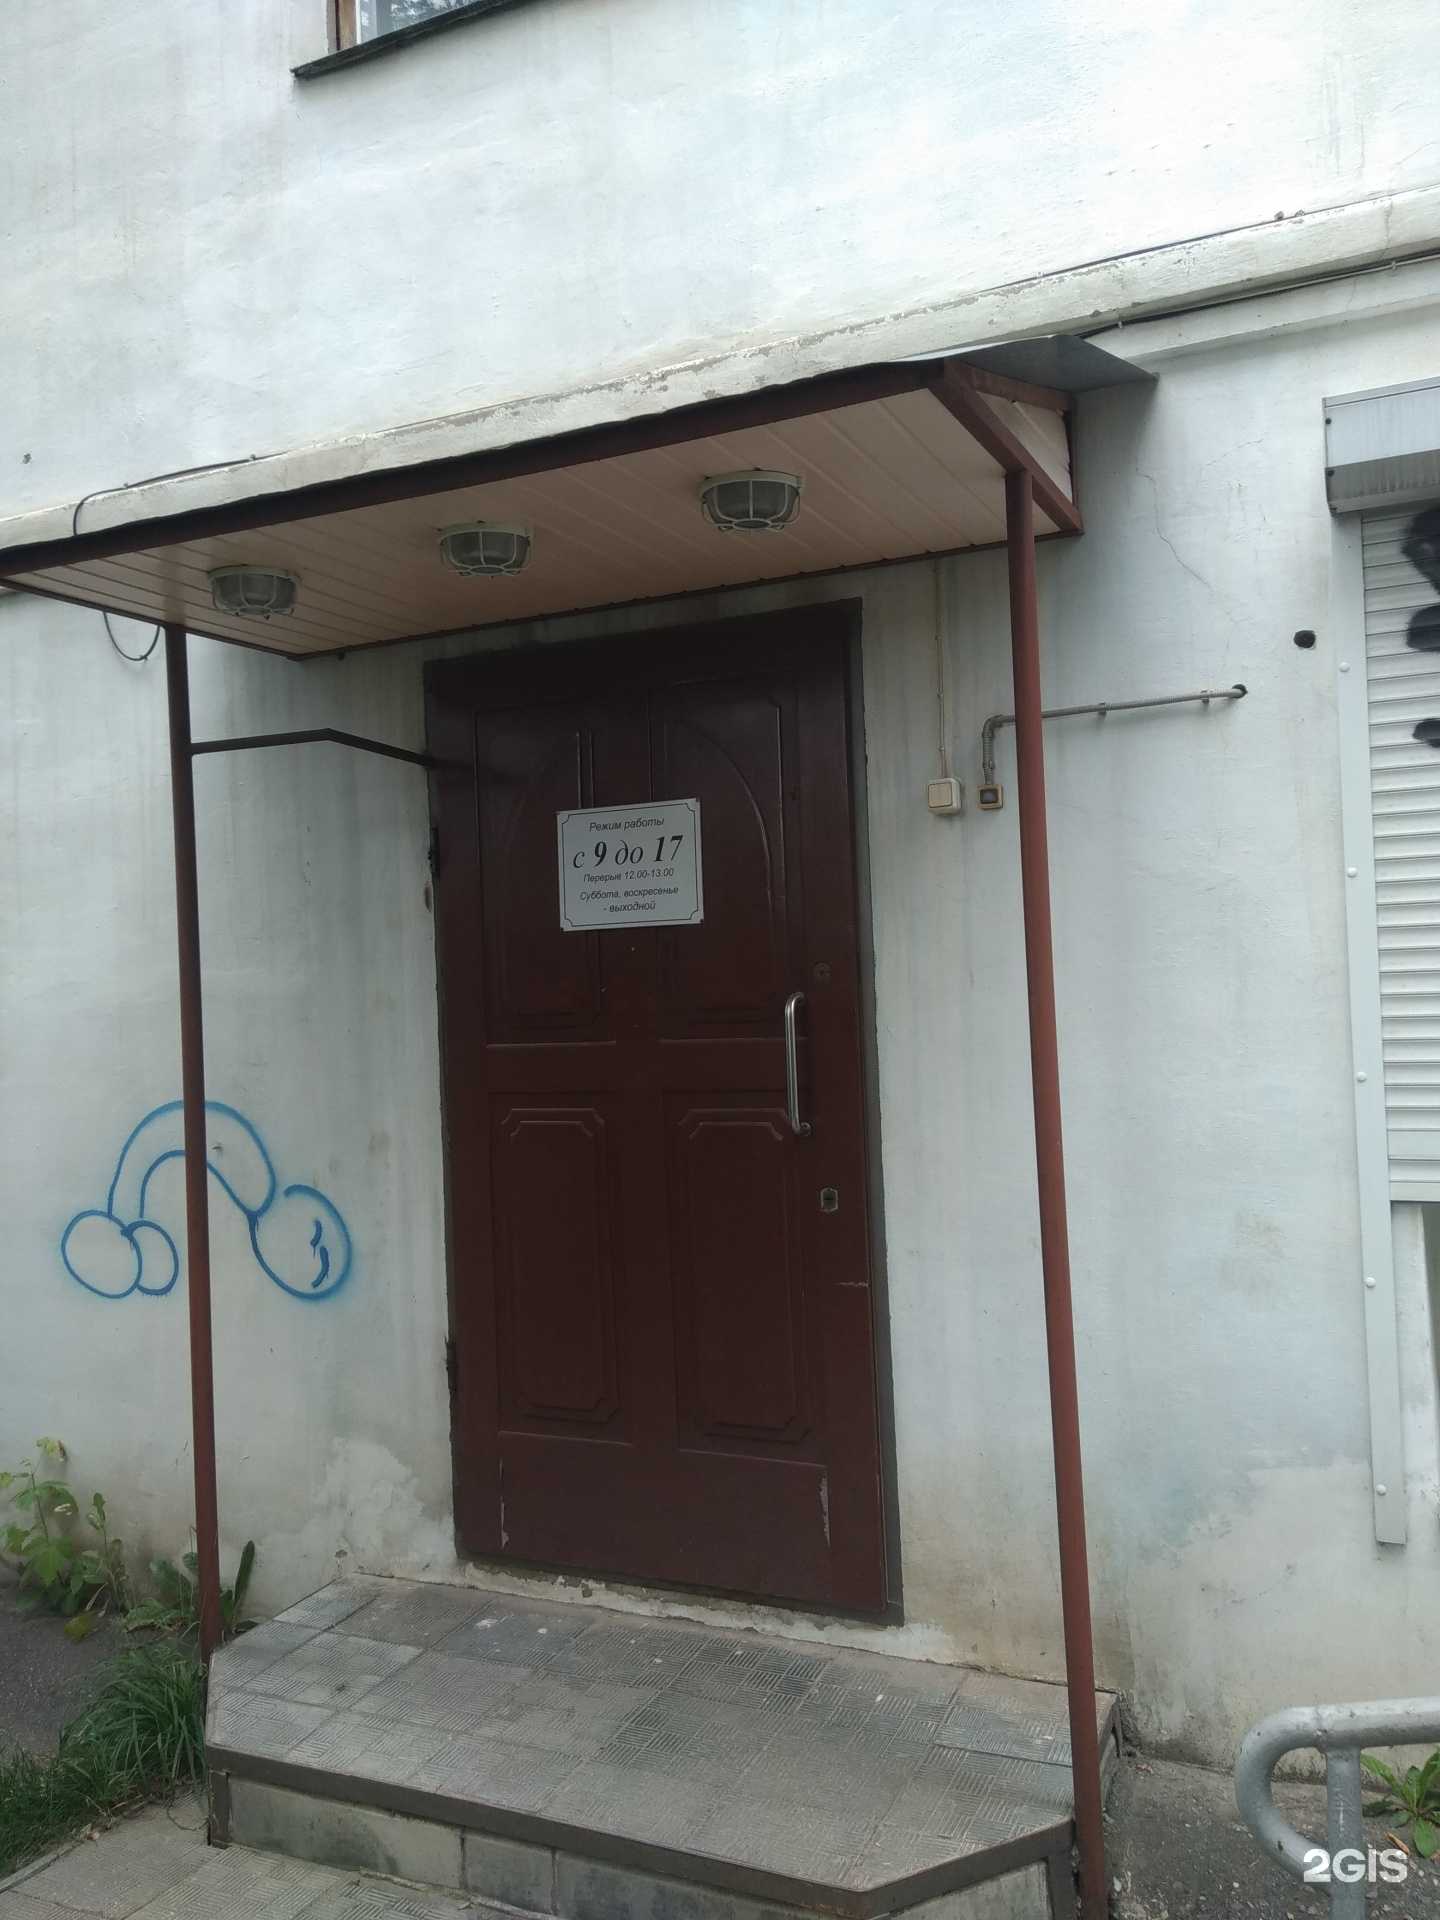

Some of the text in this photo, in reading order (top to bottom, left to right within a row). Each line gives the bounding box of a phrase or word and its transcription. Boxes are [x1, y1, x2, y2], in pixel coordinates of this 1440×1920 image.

[589, 817, 665, 832] Режим работы
[594, 841, 607, 867] 9
[614, 839, 644, 865] до
[654, 834, 684, 862] 17
[583, 871, 622, 883] Перерыв
[623, 886, 679, 899] воскресенье
[609, 901, 656, 913] выходной
